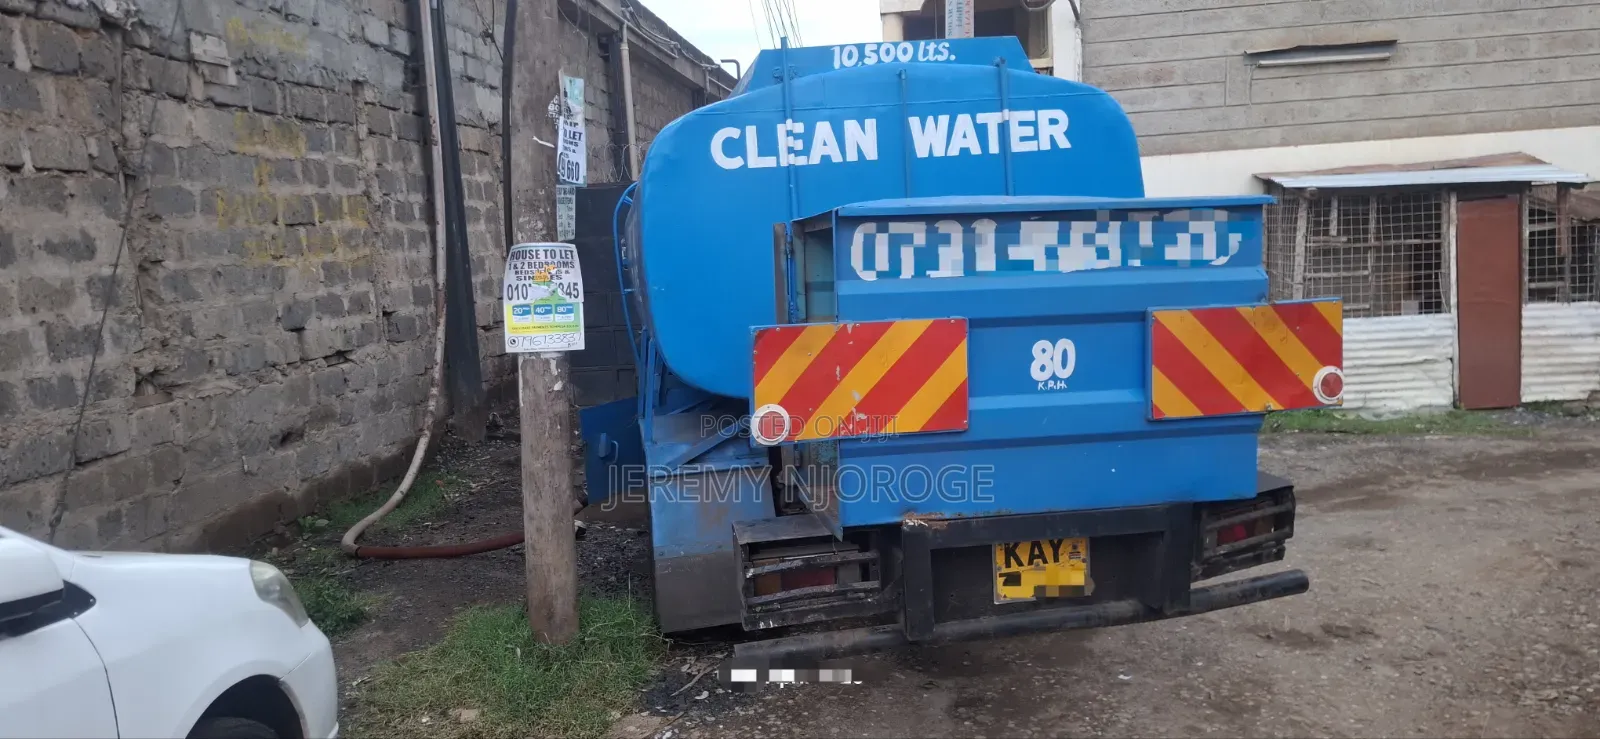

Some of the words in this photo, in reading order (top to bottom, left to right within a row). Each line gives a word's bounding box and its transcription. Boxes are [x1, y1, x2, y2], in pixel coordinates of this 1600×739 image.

[830, 42, 914, 69] 10,500
[569, 130, 583, 141] LET
[710, 118, 878, 170] CLEAN
[908, 109, 1072, 158] WATER
[509, 249, 541, 261] HOUSE
[543, 249, 557, 260] TO
[559, 249, 575, 260] LET
[1030, 338, 1076, 381] 80
[1004, 539, 1064, 568] KAY
